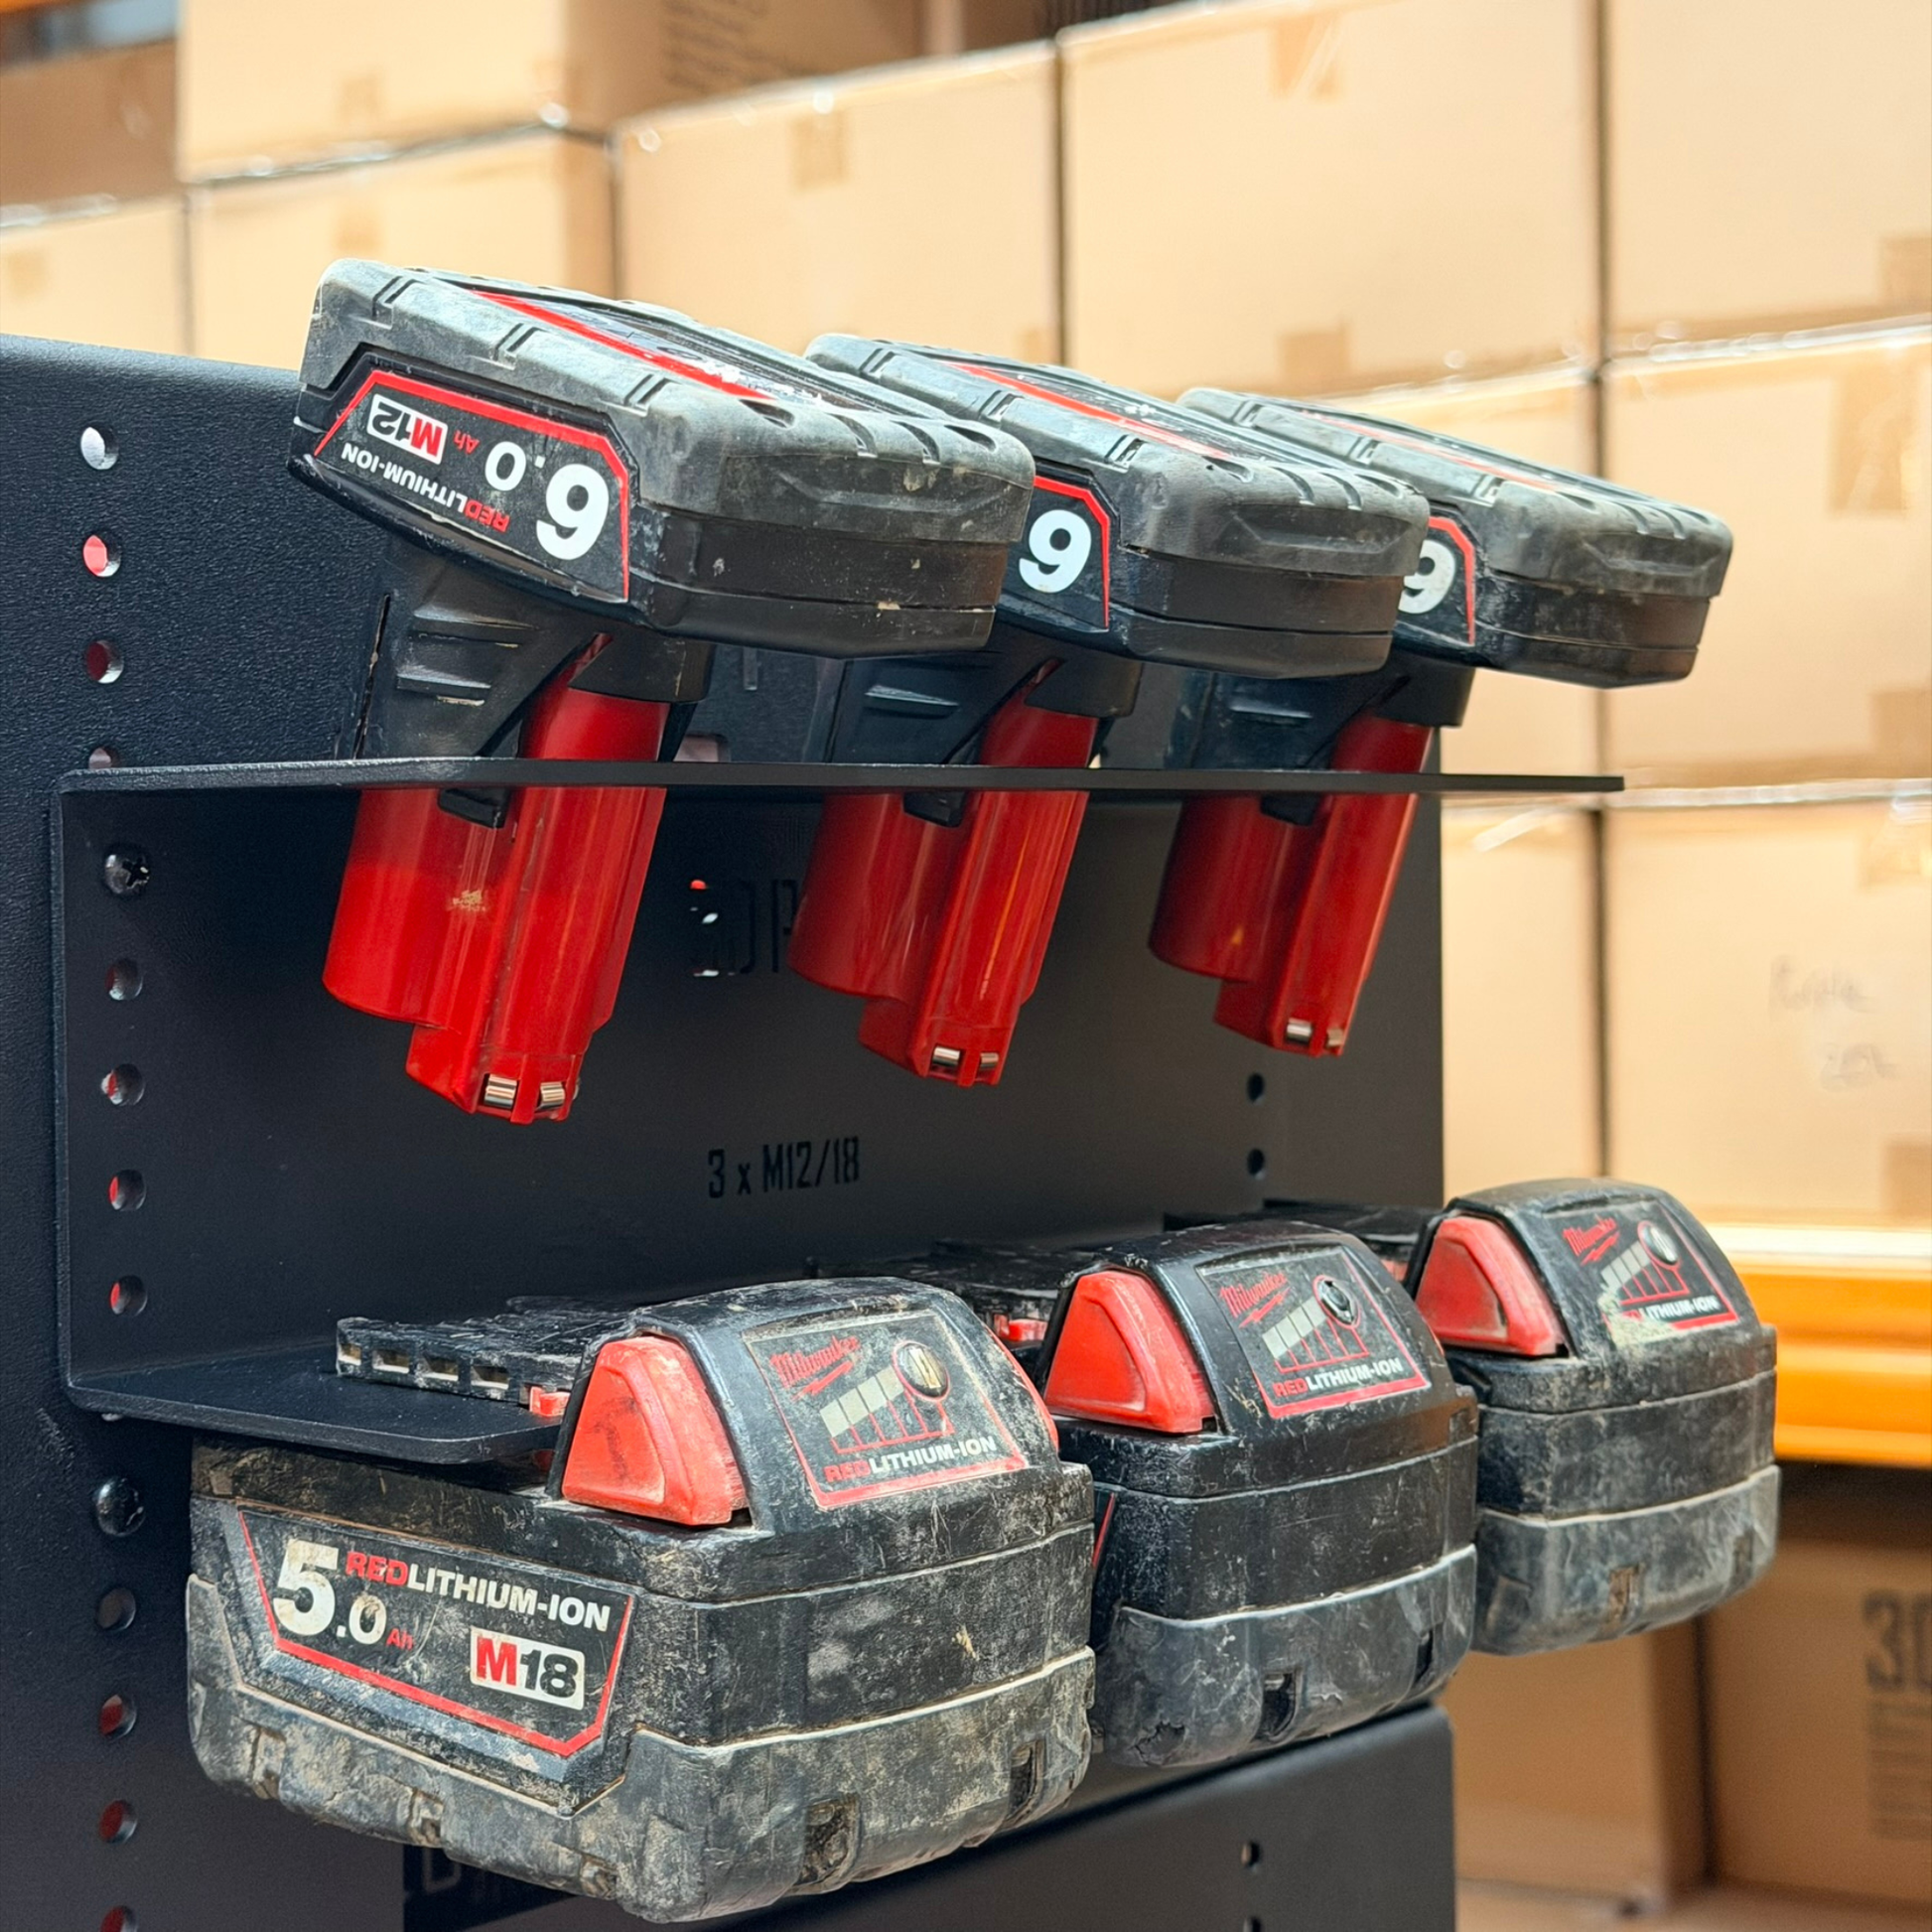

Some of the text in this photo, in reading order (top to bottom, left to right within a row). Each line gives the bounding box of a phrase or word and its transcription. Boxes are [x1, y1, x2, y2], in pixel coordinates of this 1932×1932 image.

[370, 405, 444, 458] M12
[341, 443, 510, 533] REDLITHIUM-ION
[453, 429, 610, 561] 6.0 Ah
[708, 1135, 861, 1198] 3 x M12/18
[1219, 1270, 1288, 1319] Milwaukee
[1273, 1357, 1405, 1398] REDLITHIUM-ION
[823, 1435, 998, 1483] REDLITHIUM-ION
[273, 1539, 414, 1650] 5.0 Ah
[345, 1551, 611, 1632] REDLITHIUM-ION
[476, 1636, 581, 1700] M18
